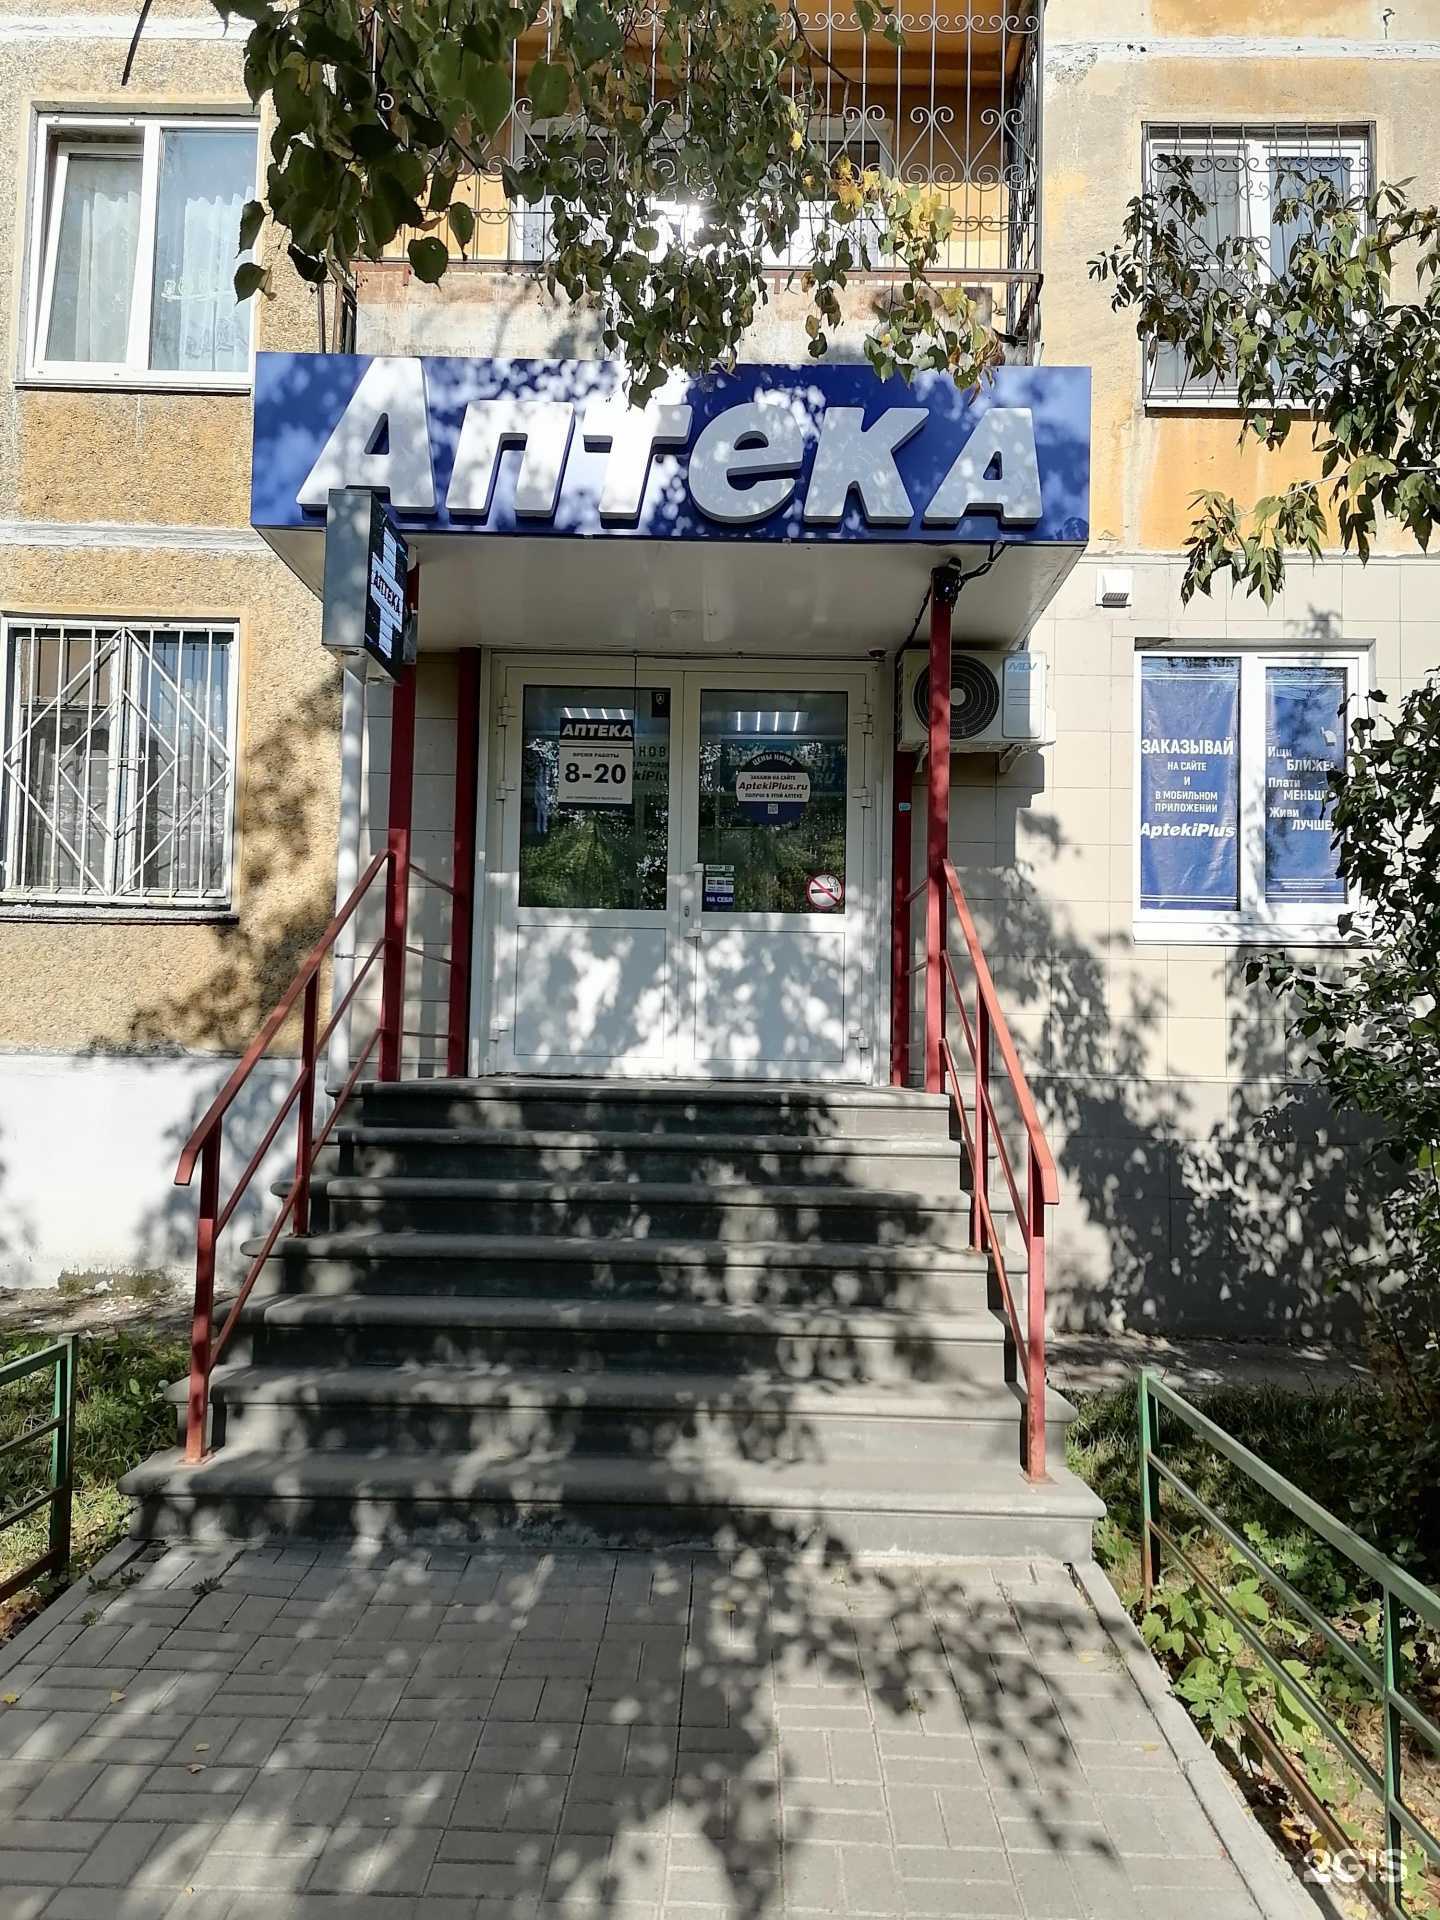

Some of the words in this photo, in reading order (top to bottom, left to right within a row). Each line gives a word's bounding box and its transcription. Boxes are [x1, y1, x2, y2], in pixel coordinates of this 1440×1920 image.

[561, 723, 633, 738] АПТЕКА
[1141, 737, 1235, 756] ЗАКАЗЫВАЙ
[1268, 746, 1292, 759] Ищи
[1167, 762, 1179, 772] НА
[1180, 760, 1207, 772] САЙТЕ
[564, 762, 626, 784] 8-20
[738, 781, 809, 791] AptekiPlus.ru
[1184, 776, 1191, 786] И
[1268, 777, 1300, 788] Плати
[1155, 792, 1161, 801] В
[1163, 791, 1218, 801] МОБИЛЬНОМ
[1283, 790, 1328, 801] МЕНЬШ
[1154, 803, 1218, 813] ПРИЛОЖЕНИИ
[1269, 806, 1299, 818] Живи
[1140, 823, 1236, 838] AptekiPlus
